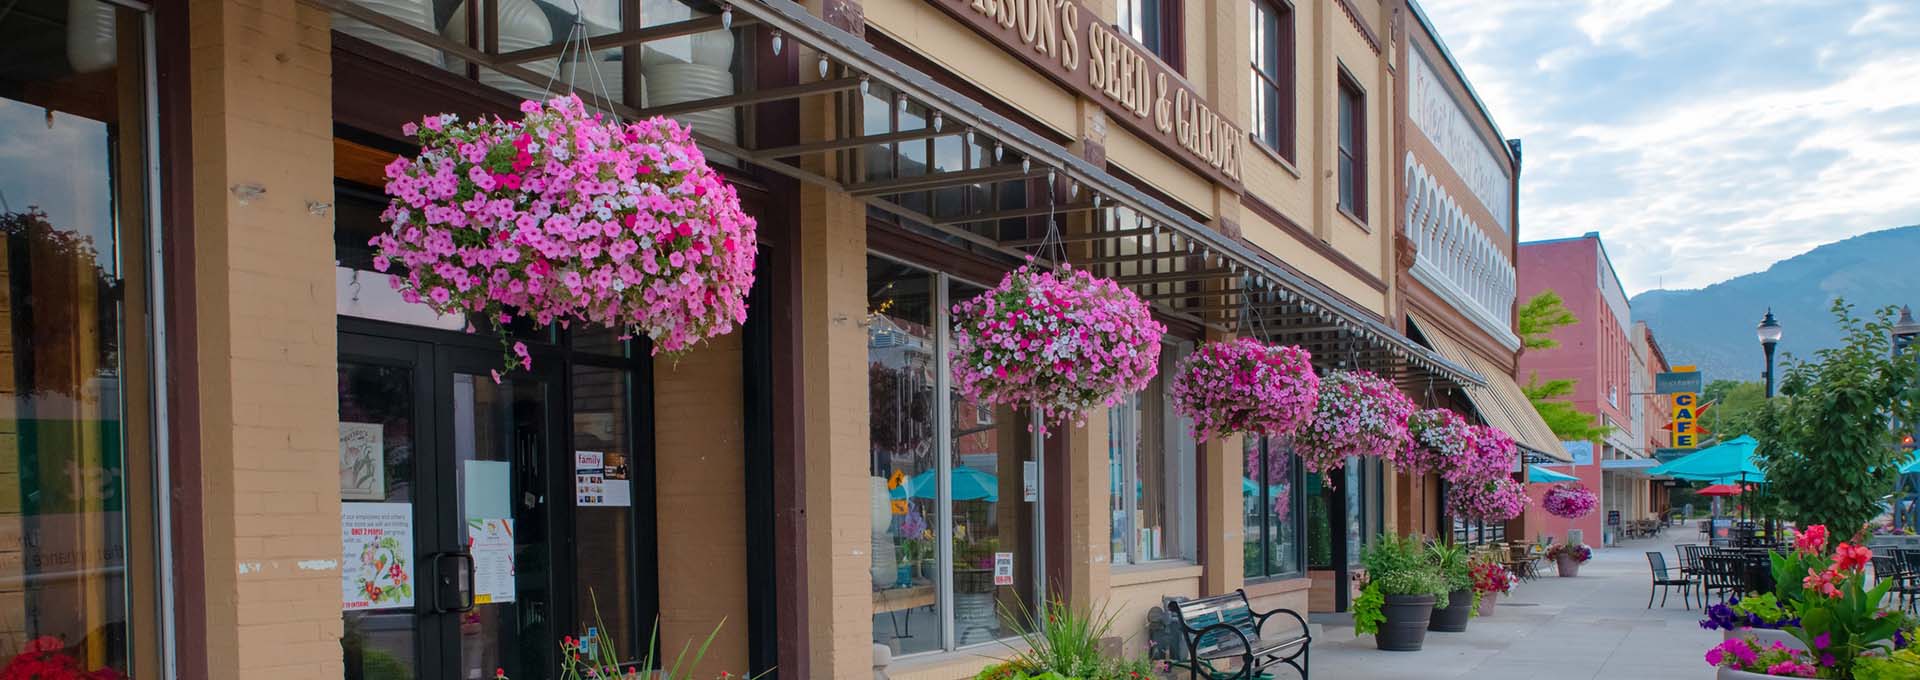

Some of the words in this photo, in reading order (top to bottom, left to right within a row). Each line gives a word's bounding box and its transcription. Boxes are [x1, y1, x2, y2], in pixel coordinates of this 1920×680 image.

[1088, 21, 1151, 119] SEED
[1155, 72, 1172, 135] &
[1175, 87, 1245, 183] GARDEN
[1676, 395, 1692, 446] CAFE
[351, 528, 363, 536] ONLY
[363, 528, 367, 536] 2
[367, 528, 383, 536] PEOPLE
